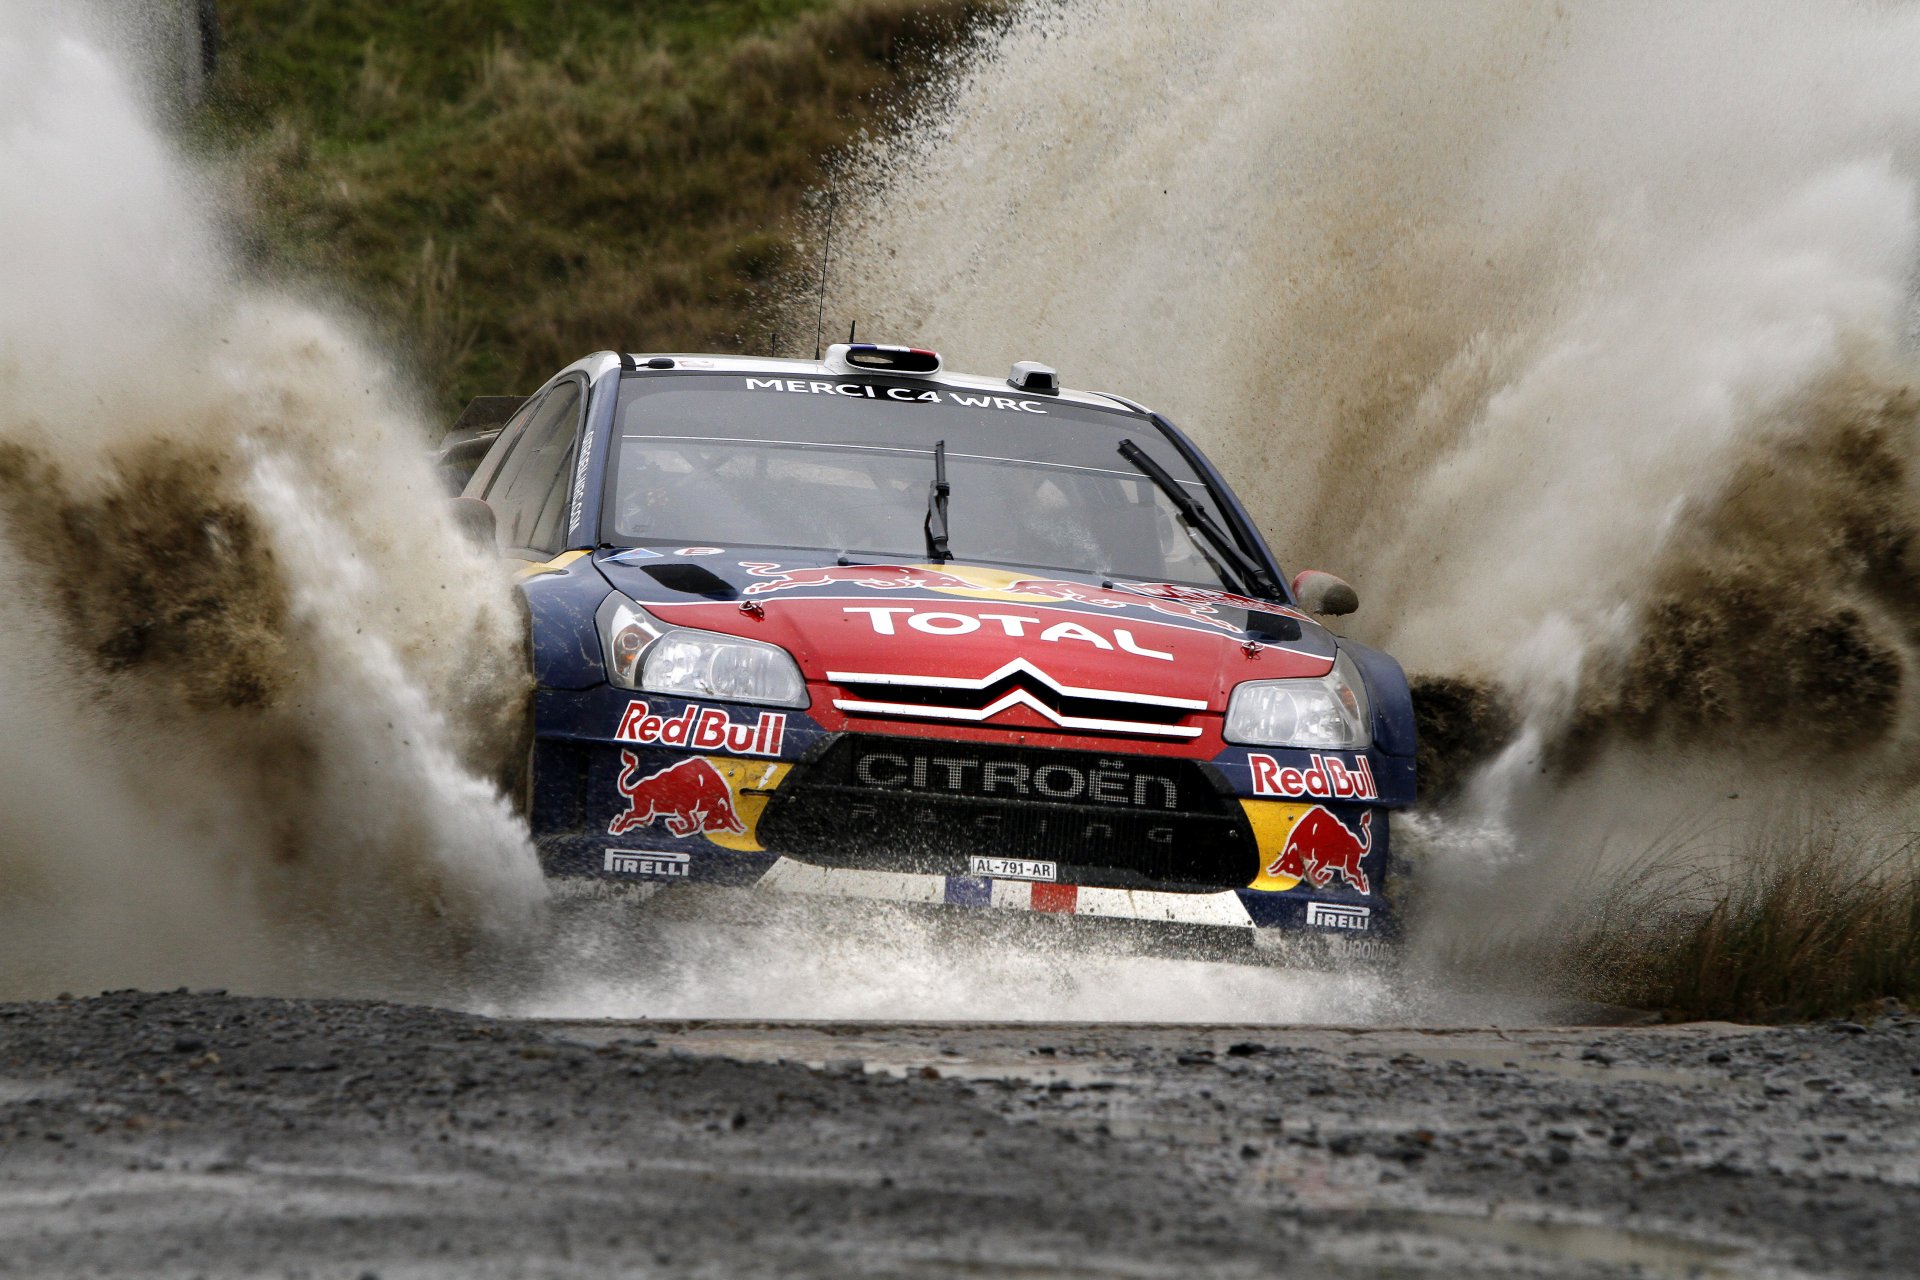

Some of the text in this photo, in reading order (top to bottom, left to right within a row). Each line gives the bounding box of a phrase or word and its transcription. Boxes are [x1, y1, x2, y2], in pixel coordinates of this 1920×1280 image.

[746, 378, 1047, 414] MERCI C4 WRC
[843, 607, 1174, 661] TOTAL
[614, 700, 787, 756] Red Bull
[1248, 753, 1378, 799] Red Bull
[604, 848, 690, 876] PIRELLI
[976, 860, 1051, 877] AL-791-AR
[1306, 901, 1370, 930] PIRELLI
